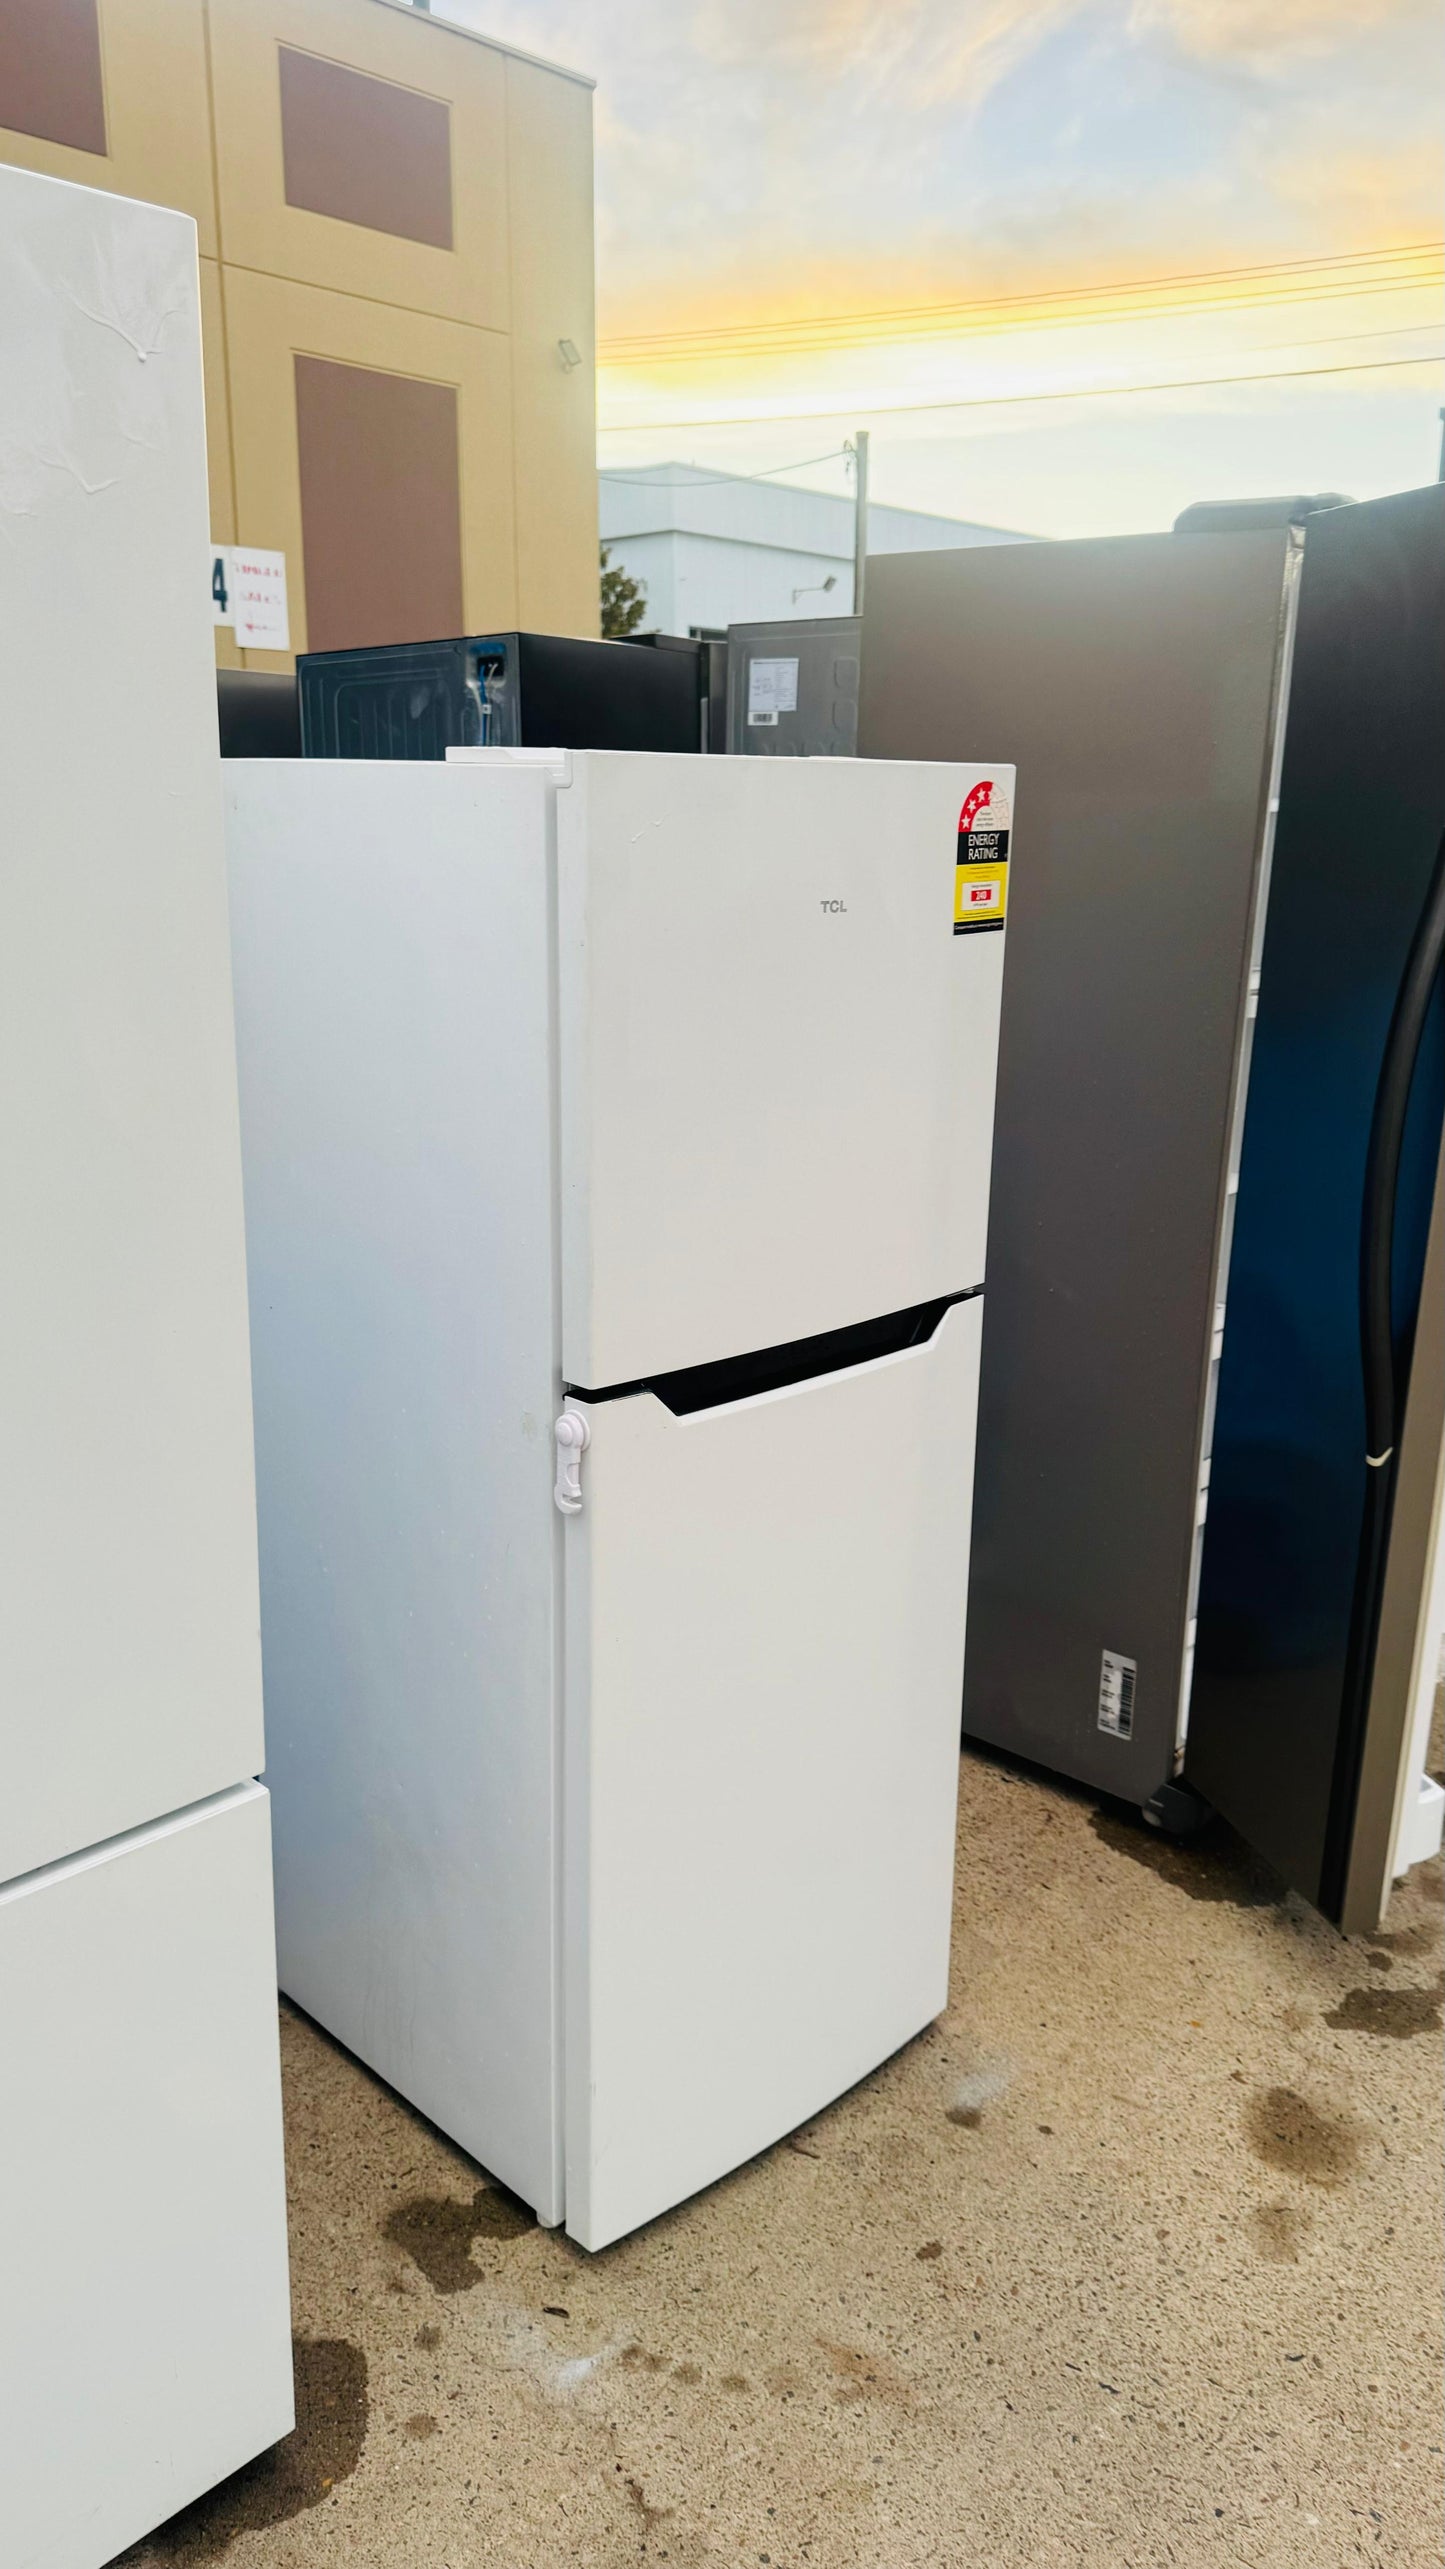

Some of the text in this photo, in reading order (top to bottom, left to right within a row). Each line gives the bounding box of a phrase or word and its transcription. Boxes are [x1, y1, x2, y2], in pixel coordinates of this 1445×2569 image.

[212, 558, 228, 613] 4
[968, 833, 1000, 847] ENERGY
[968, 847, 998, 860] RATING
[820, 900, 847, 913] TCL
